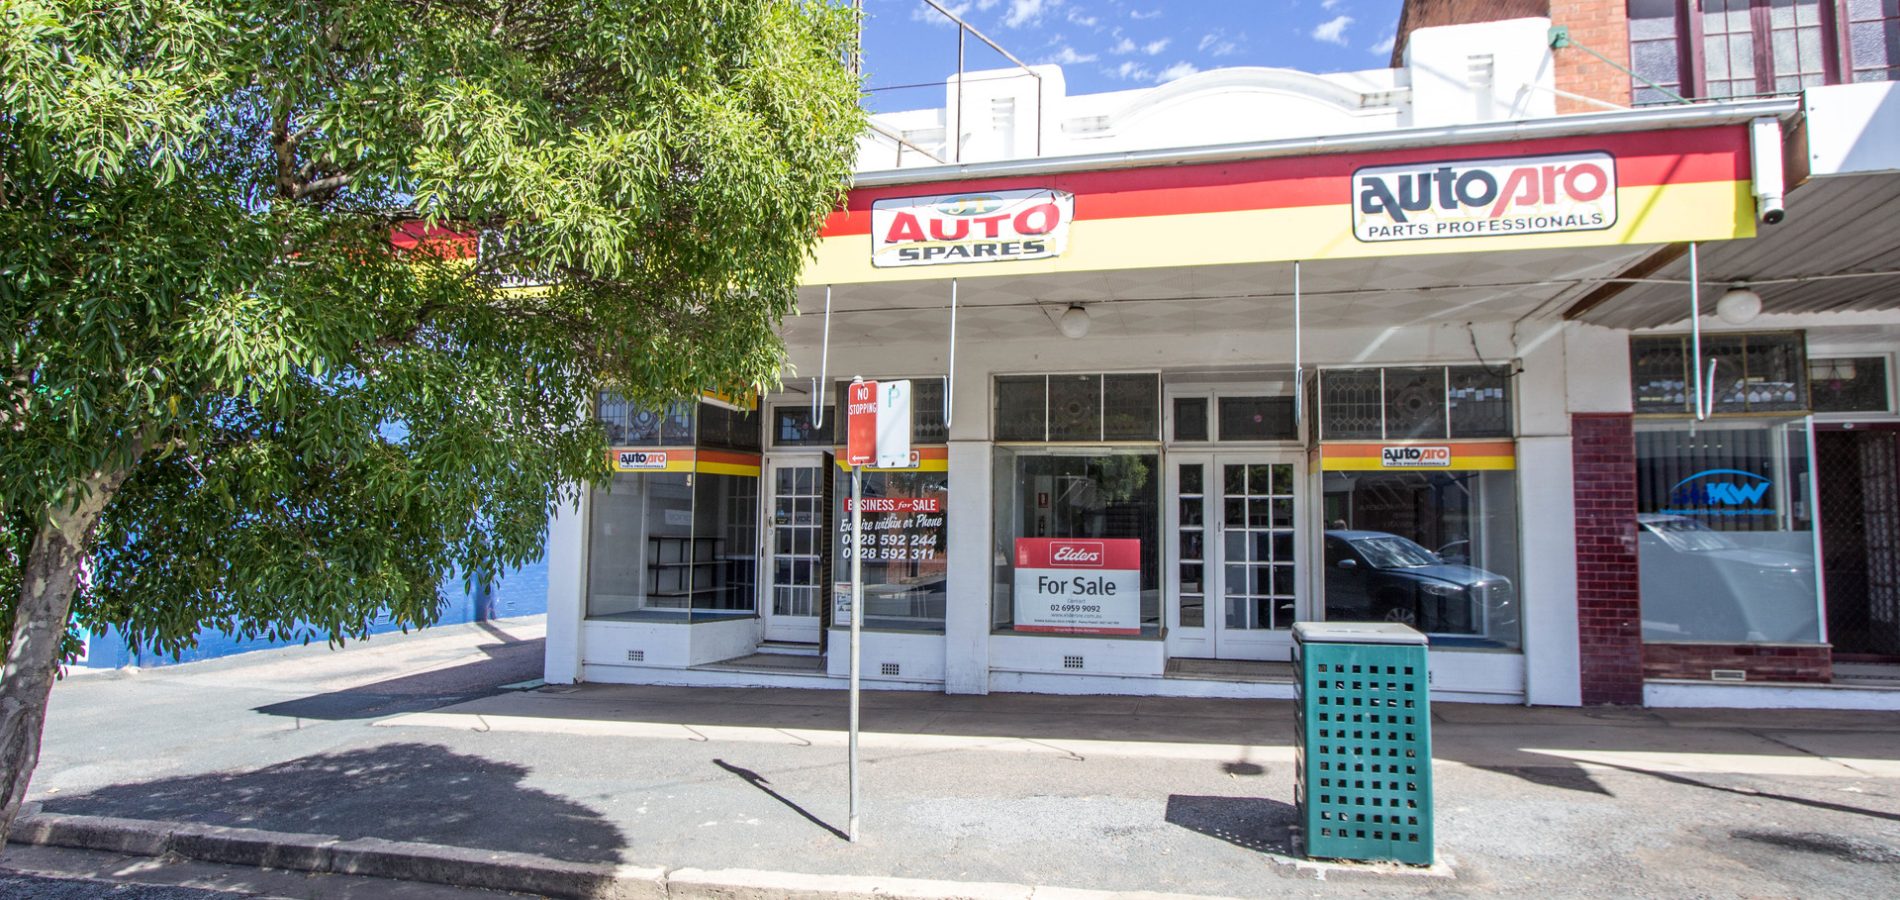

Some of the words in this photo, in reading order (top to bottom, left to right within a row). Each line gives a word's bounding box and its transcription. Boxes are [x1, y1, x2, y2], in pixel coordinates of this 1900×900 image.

[884, 203, 1060, 243] AUTO
[1368, 223, 1429, 238] PARTS
[1436, 212, 1604, 234] PROFESSIONALS
[899, 239, 1045, 261] SPARES
[857, 387, 869, 400] NO
[849, 402, 877, 415] STOPPING
[1706, 482, 1770, 505] KW
[847, 500, 894, 511] BSINESS
[895, 501, 912, 511] for
[912, 500, 936, 511] SALE
[840, 519, 873, 532] Enire
[875, 516, 902, 531] within
[903, 520, 913, 530] or
[915, 514, 943, 528] Phone
[842, 534, 876, 545] 028
[880, 534, 906, 546] 592
[910, 534, 937, 546] 244
[843, 548, 876, 559] 028
[881, 548, 907, 560] 592
[911, 548, 935, 560] 311
[1054, 547, 1099, 561] Elders
[1038, 576, 1068, 595] For
[1073, 576, 1116, 596] Sale
[1062, 604, 1080, 612] 6959
